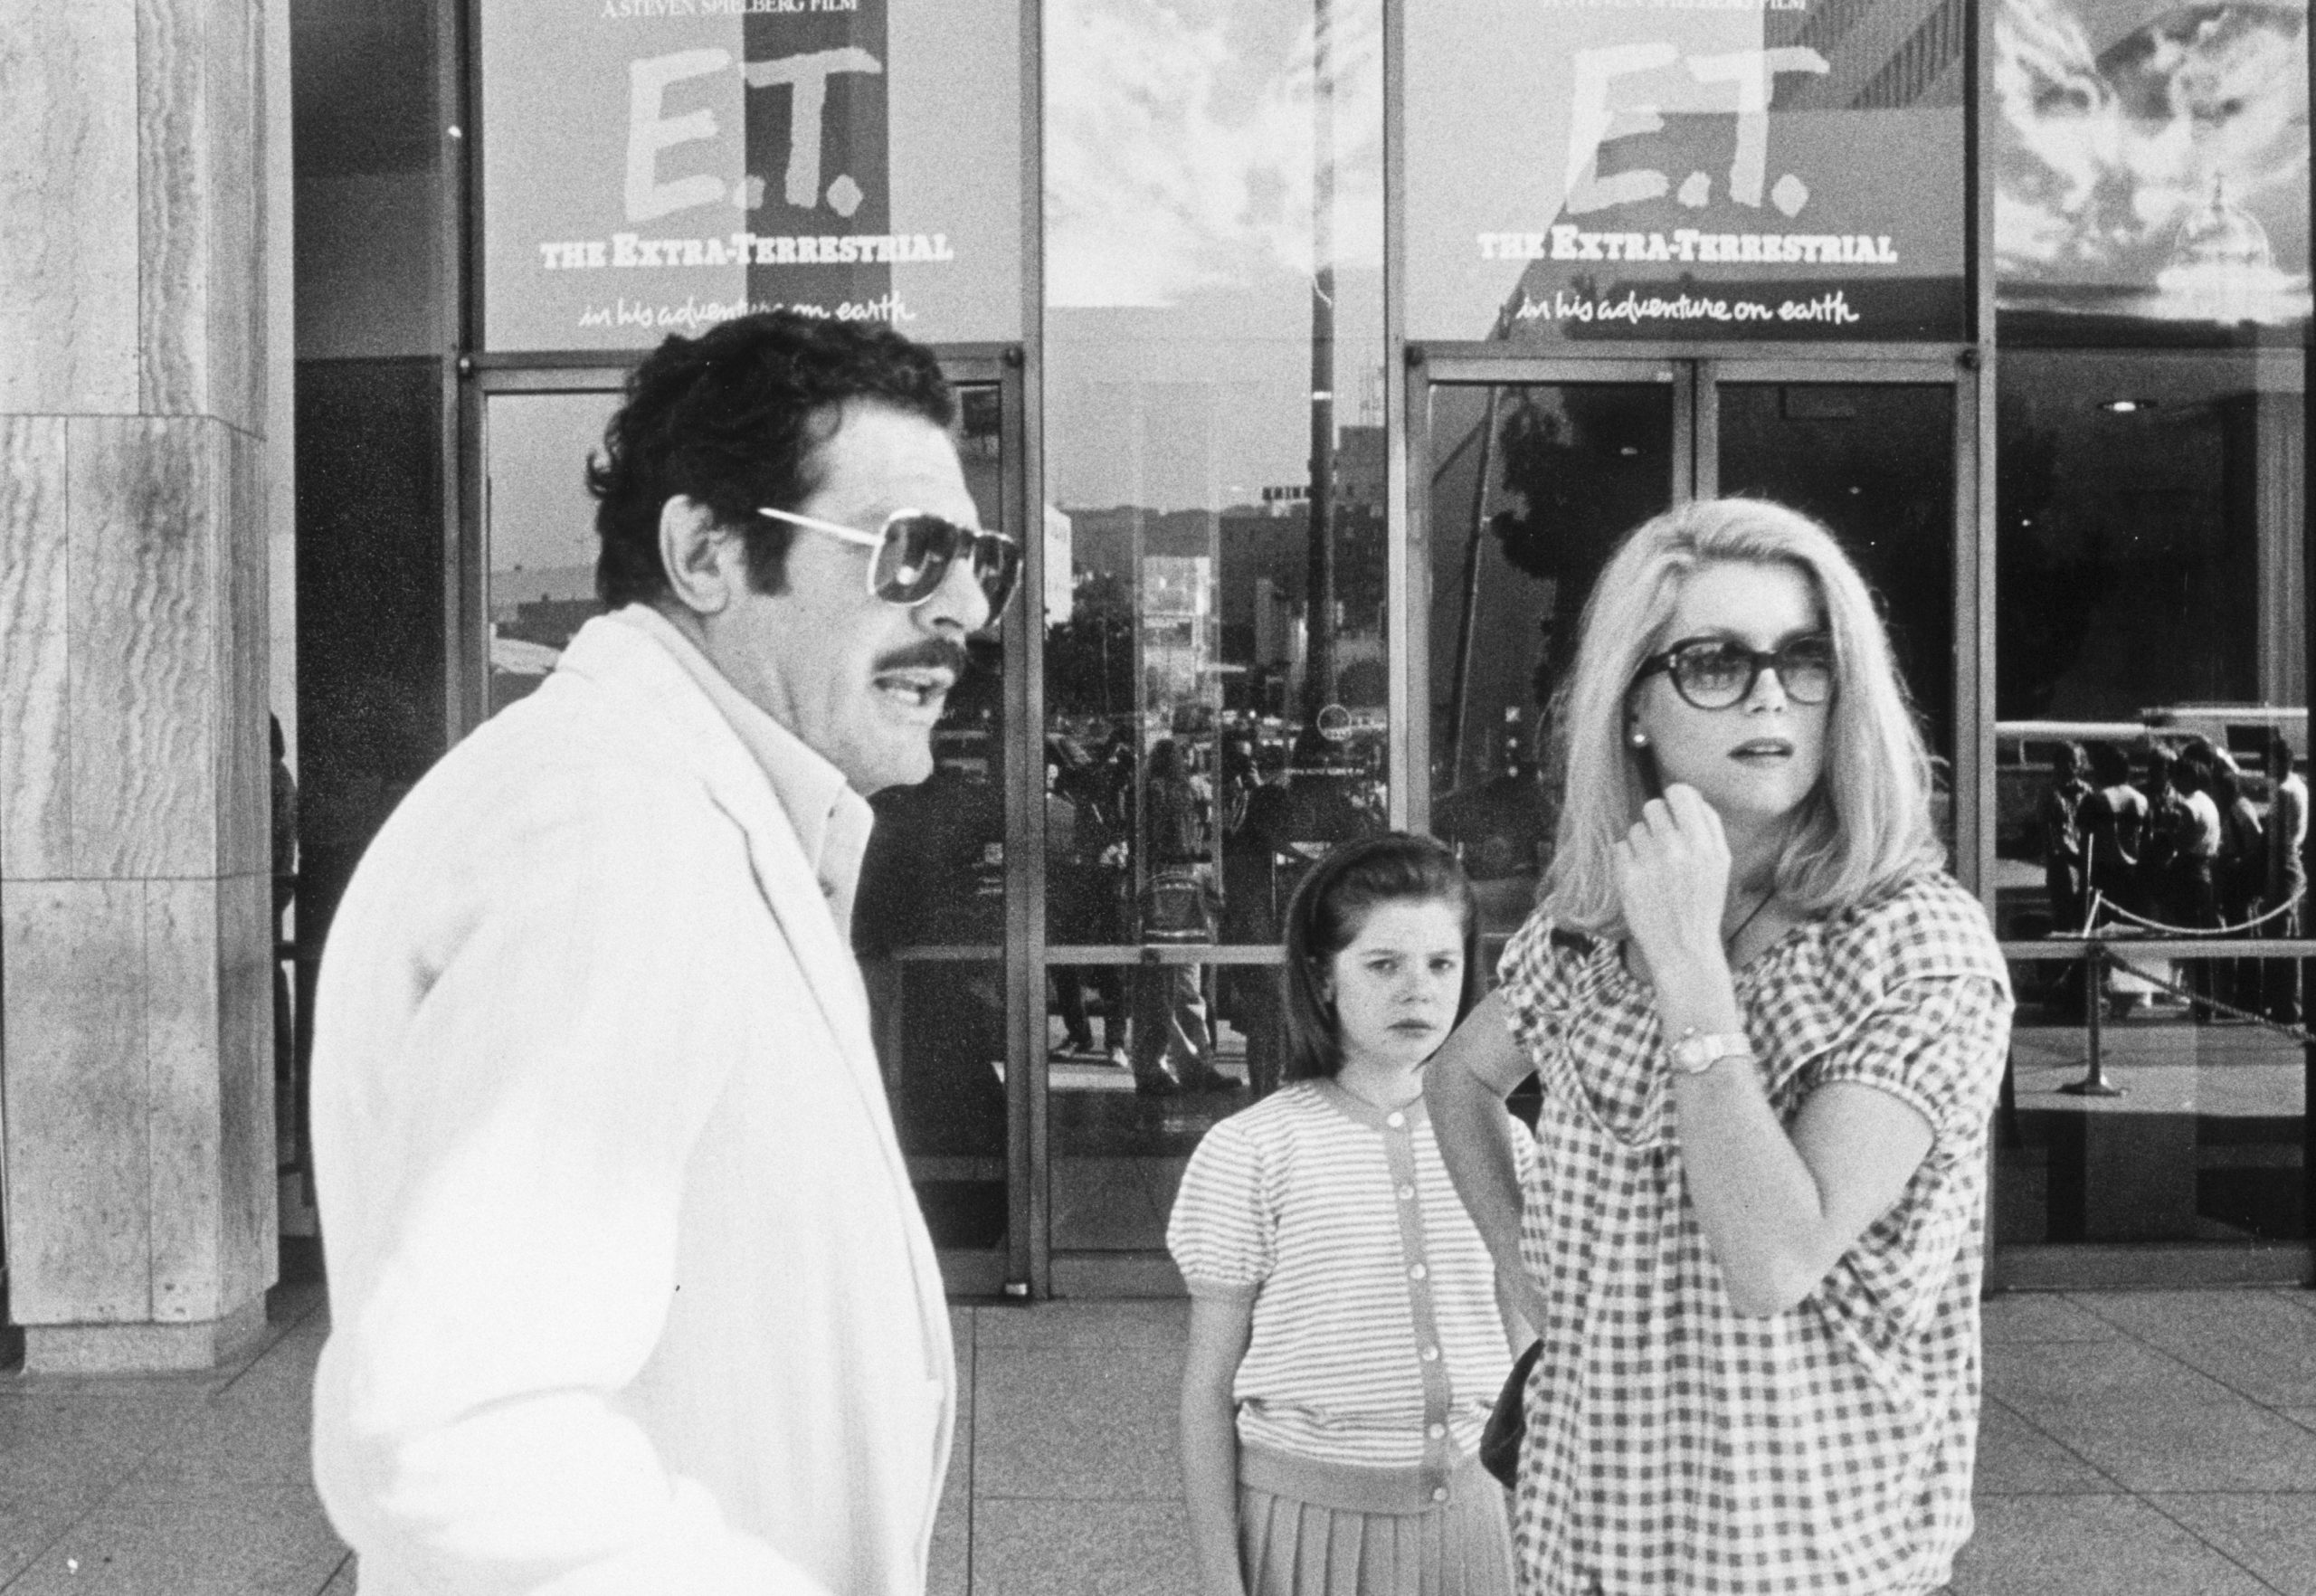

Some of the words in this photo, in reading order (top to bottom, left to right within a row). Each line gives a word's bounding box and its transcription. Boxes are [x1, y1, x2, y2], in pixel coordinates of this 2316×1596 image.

[625, 45, 883, 223] E.T.
[1565, 42, 1830, 218] E.T.
[540, 241, 606, 269] THE
[1476, 232, 1545, 260] THE
[578, 305, 613, 328] in
[617, 297, 653, 329] his
[836, 290, 916, 324] earth
[1516, 295, 1552, 320] in
[1556, 290, 1593, 323] his
[1597, 289, 1732, 325] adventure
[1734, 300, 1773, 321] on
[1778, 290, 1860, 326] earth
